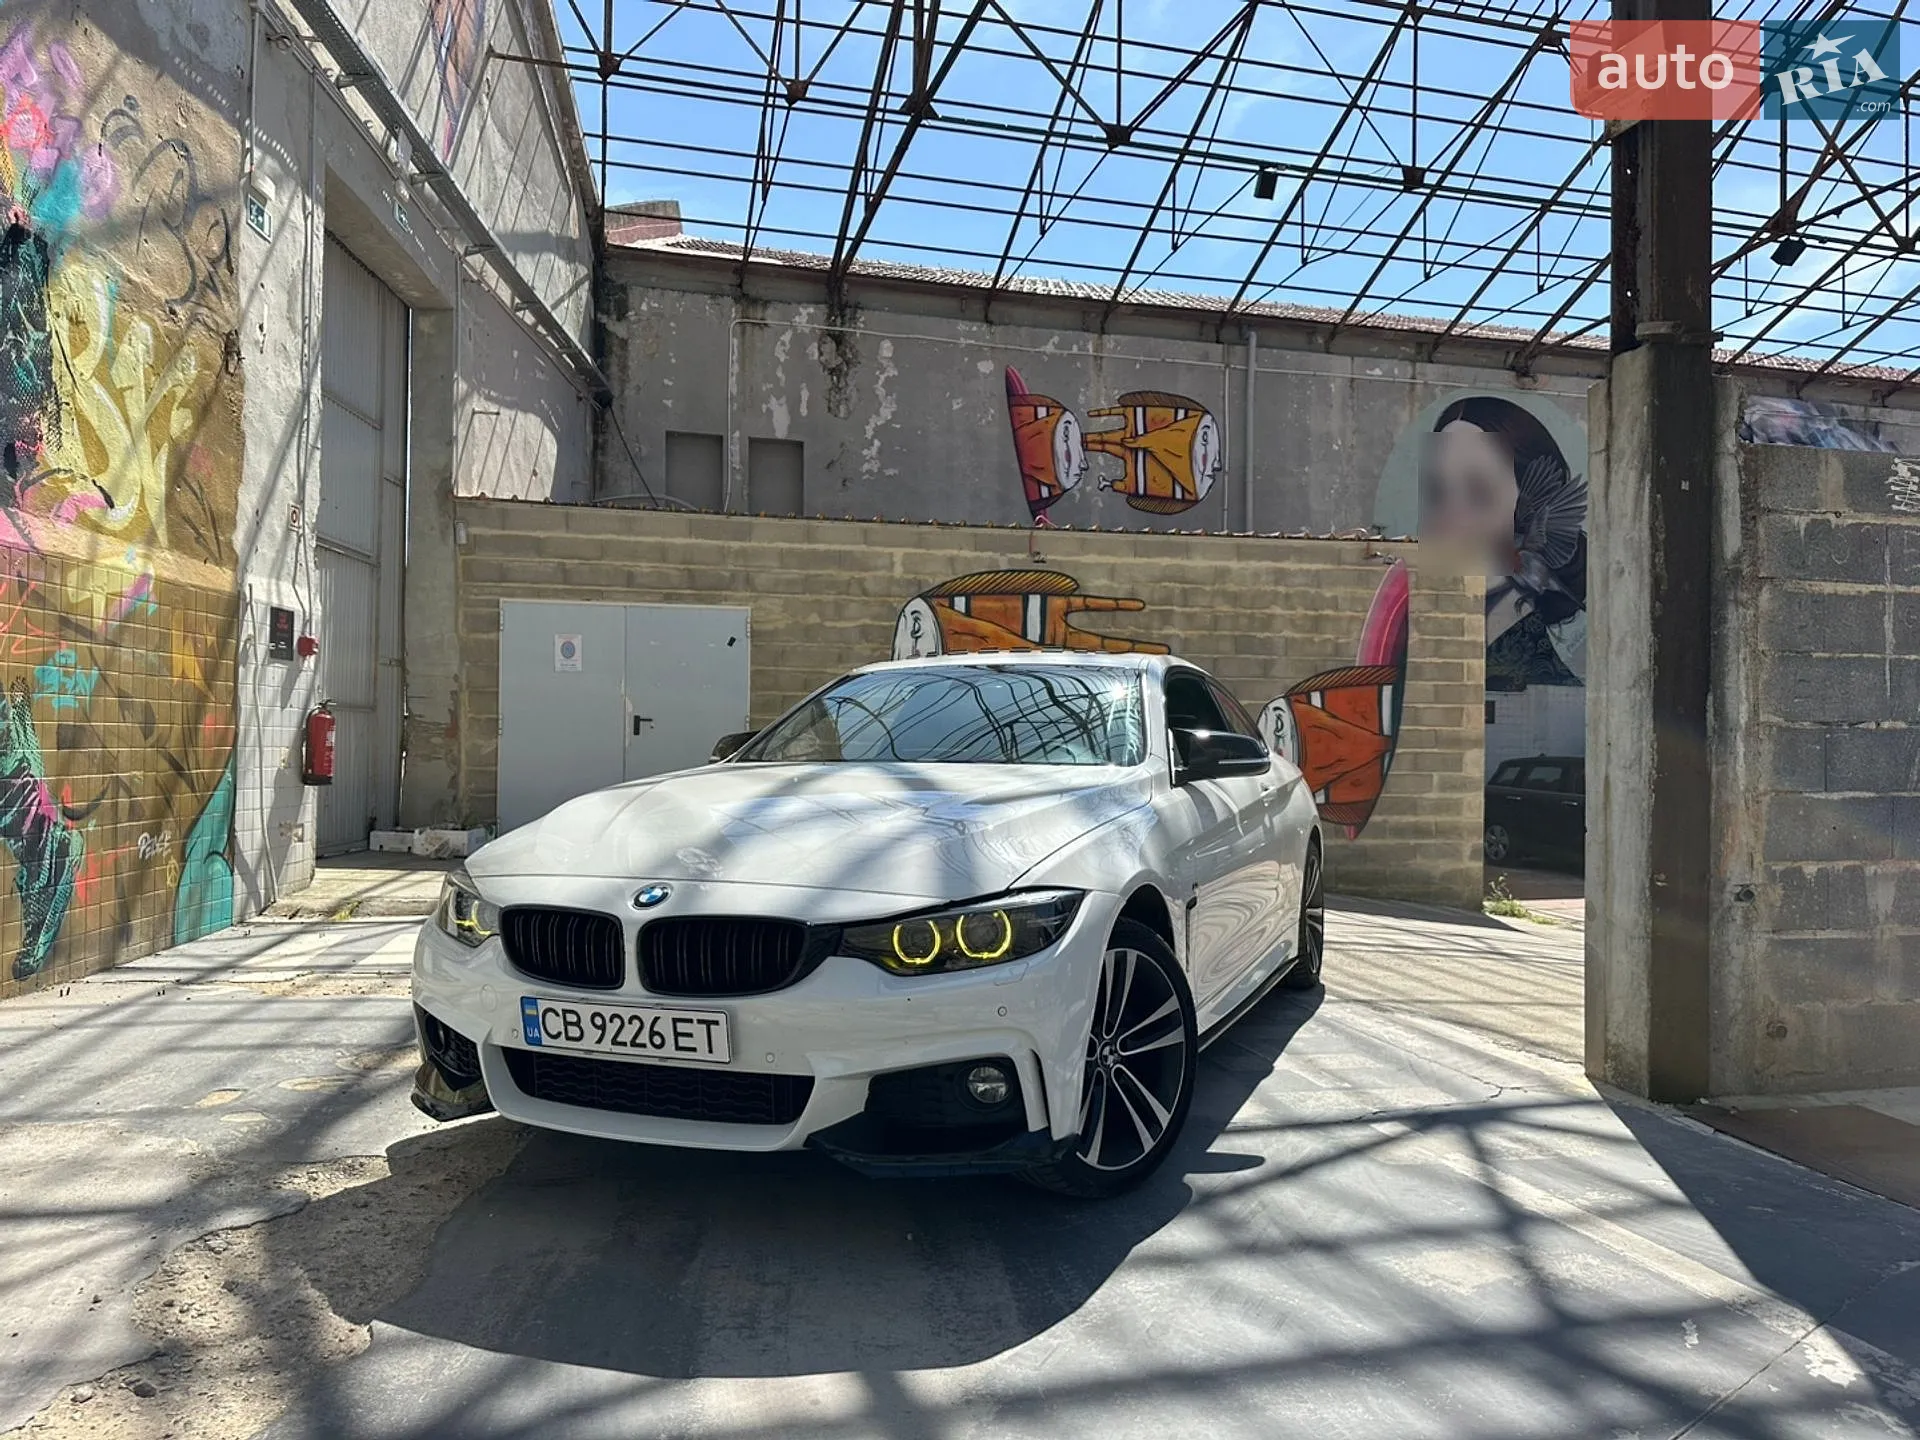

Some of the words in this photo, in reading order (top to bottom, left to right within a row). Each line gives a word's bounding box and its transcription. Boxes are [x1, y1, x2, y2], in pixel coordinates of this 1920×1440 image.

[526, 1026, 540, 1038] UA
[541, 1007, 584, 1042] CB
[590, 1012, 666, 1050] 9226
[671, 1017, 720, 1055] ET
